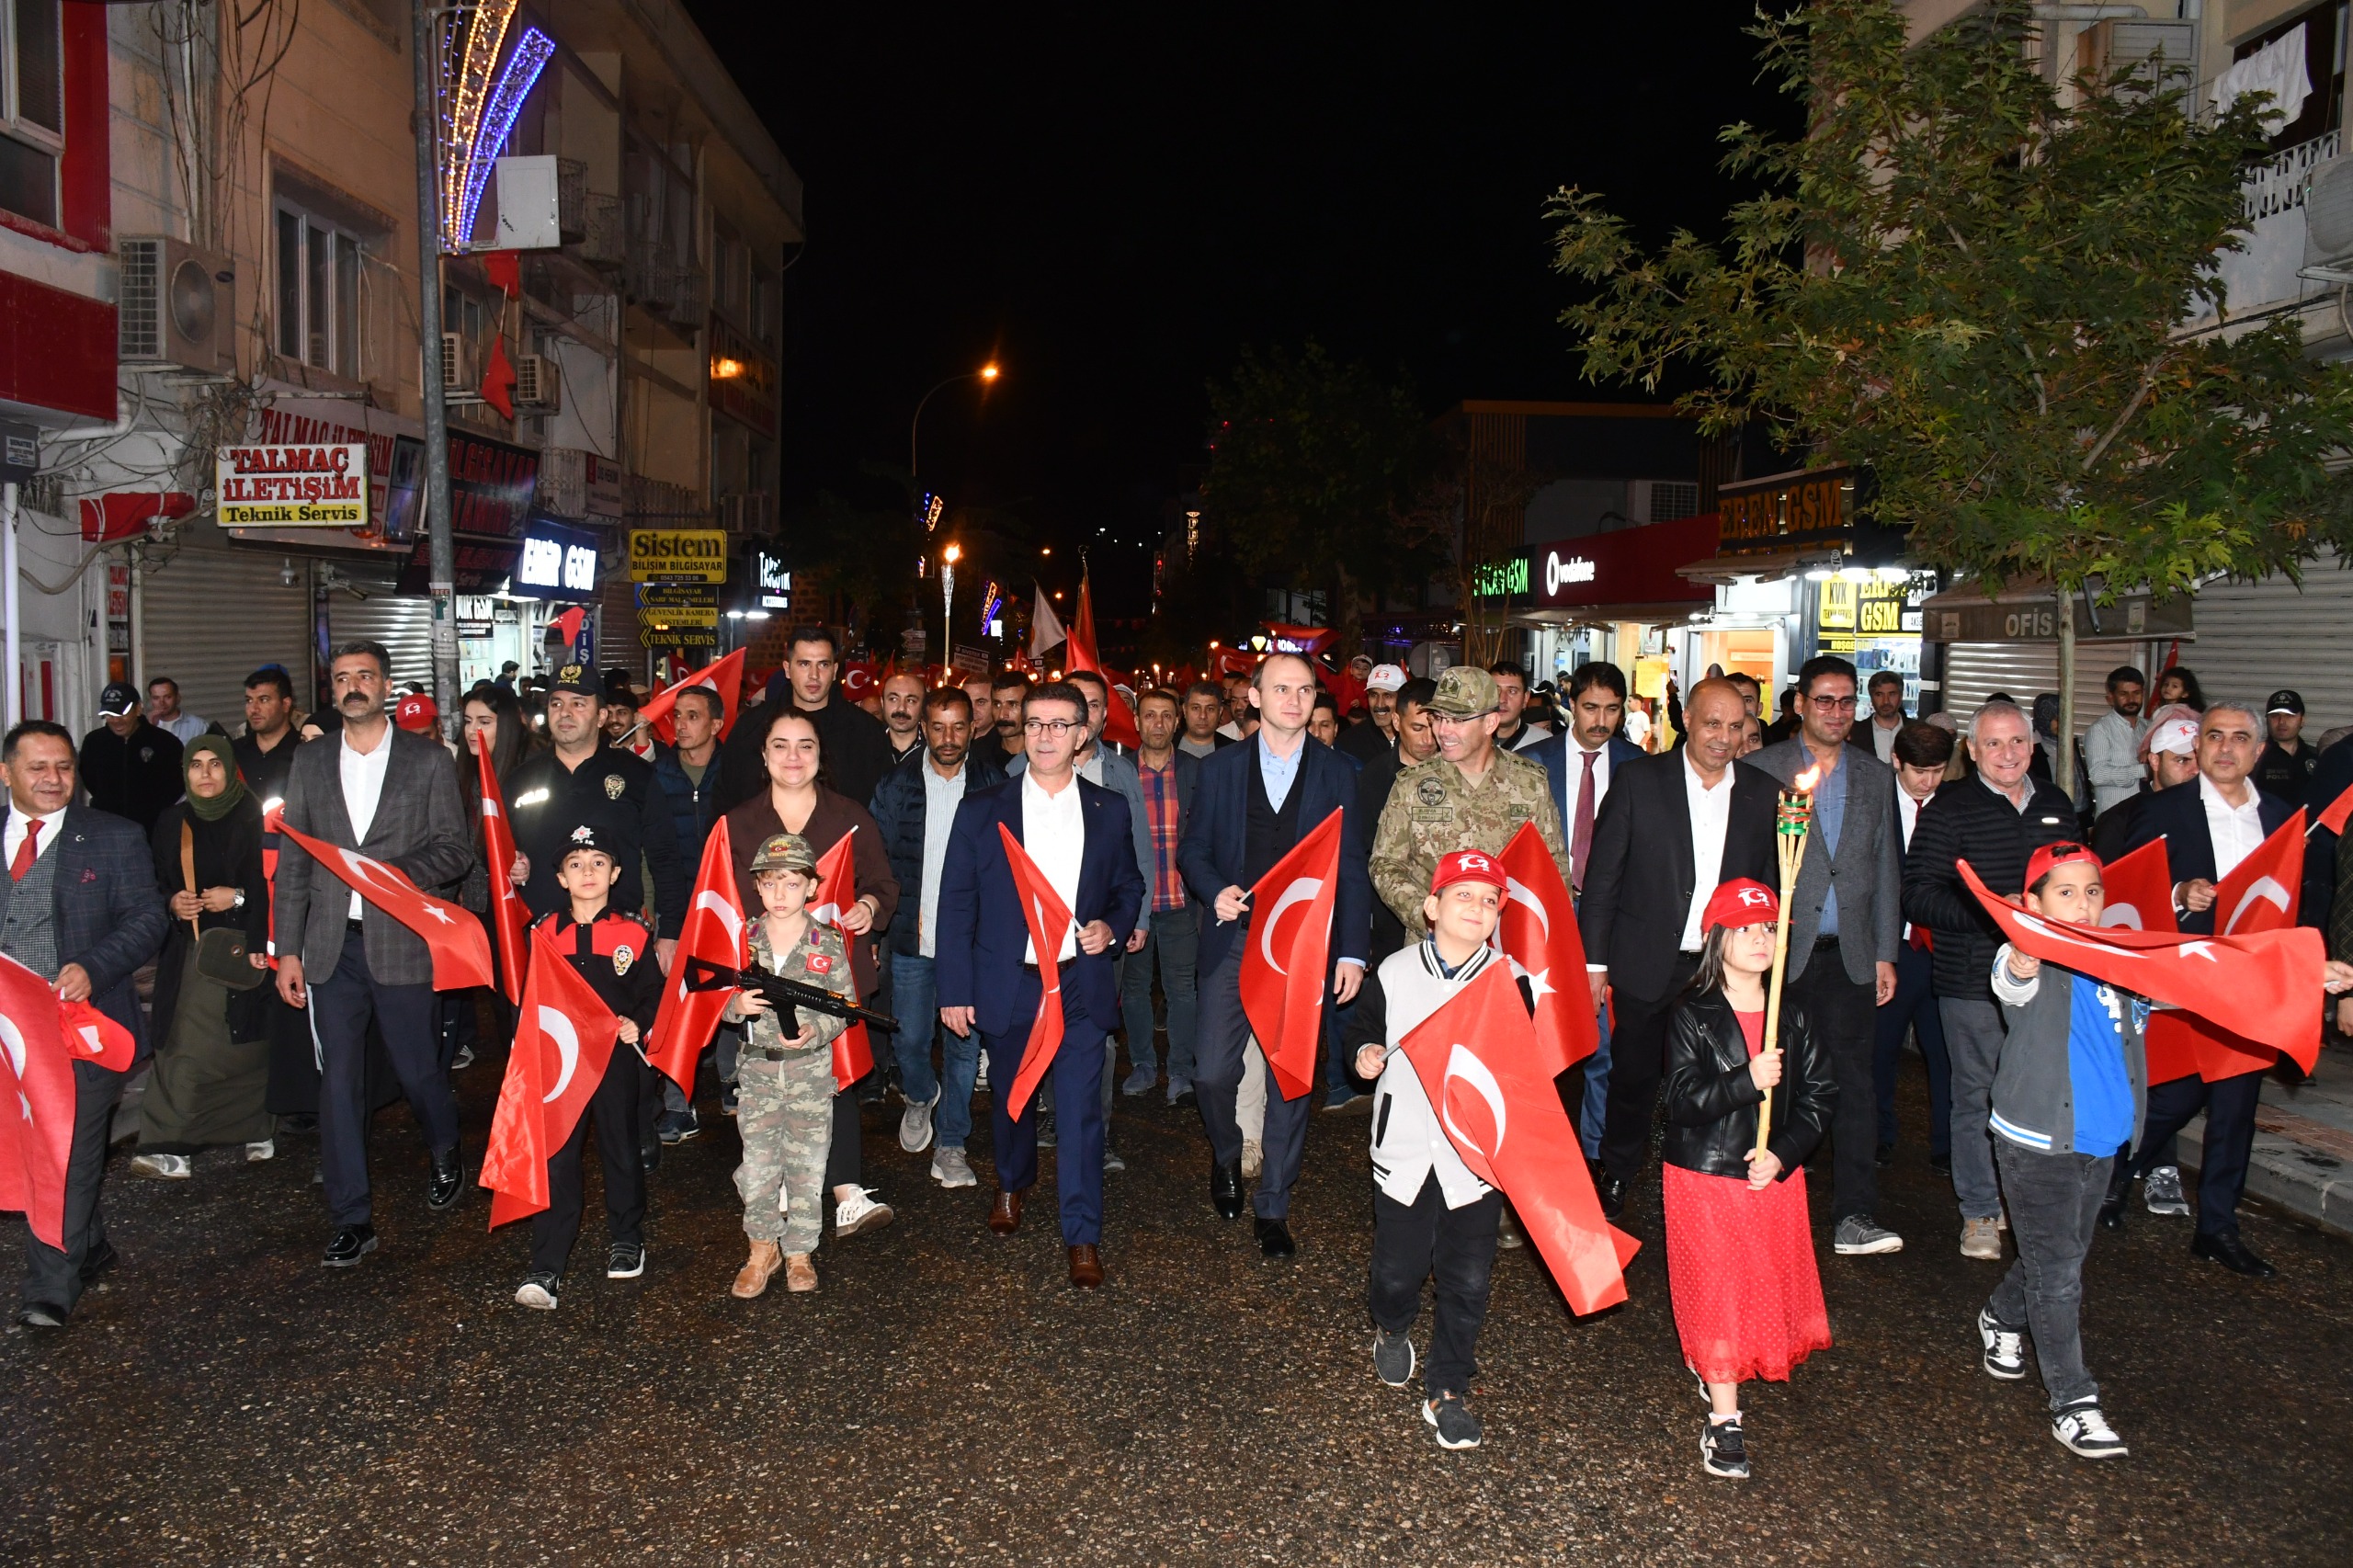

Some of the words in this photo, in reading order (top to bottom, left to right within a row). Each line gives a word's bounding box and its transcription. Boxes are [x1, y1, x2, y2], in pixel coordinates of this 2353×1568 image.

[230, 447, 349, 478] TALMAÇ
[448, 437, 537, 490] İLGİSAYAR
[227, 506, 292, 522] Teknik
[298, 506, 358, 522] Servis
[1719, 490, 1780, 540] EREN
[1785, 477, 1845, 532] GSM
[634, 533, 722, 558] Sistem
[564, 544, 597, 591] GSM
[632, 559, 666, 573] BİLİŞİM
[670, 559, 722, 571] BİLGİSAYAR
[1559, 555, 1596, 584] vodafone
[663, 586, 702, 595] BİLGİSAYAR
[1829, 582, 1847, 605] KVK
[648, 608, 684, 617] GÜVENLİK
[686, 608, 715, 617] KAMERA
[661, 617, 703, 626] SİSTEMLERİ
[1860, 601, 1899, 631] GSM
[2006, 608, 2052, 636] OFİS
[650, 631, 681, 645] TEKNİK
[684, 632, 715, 645] SERVİS
